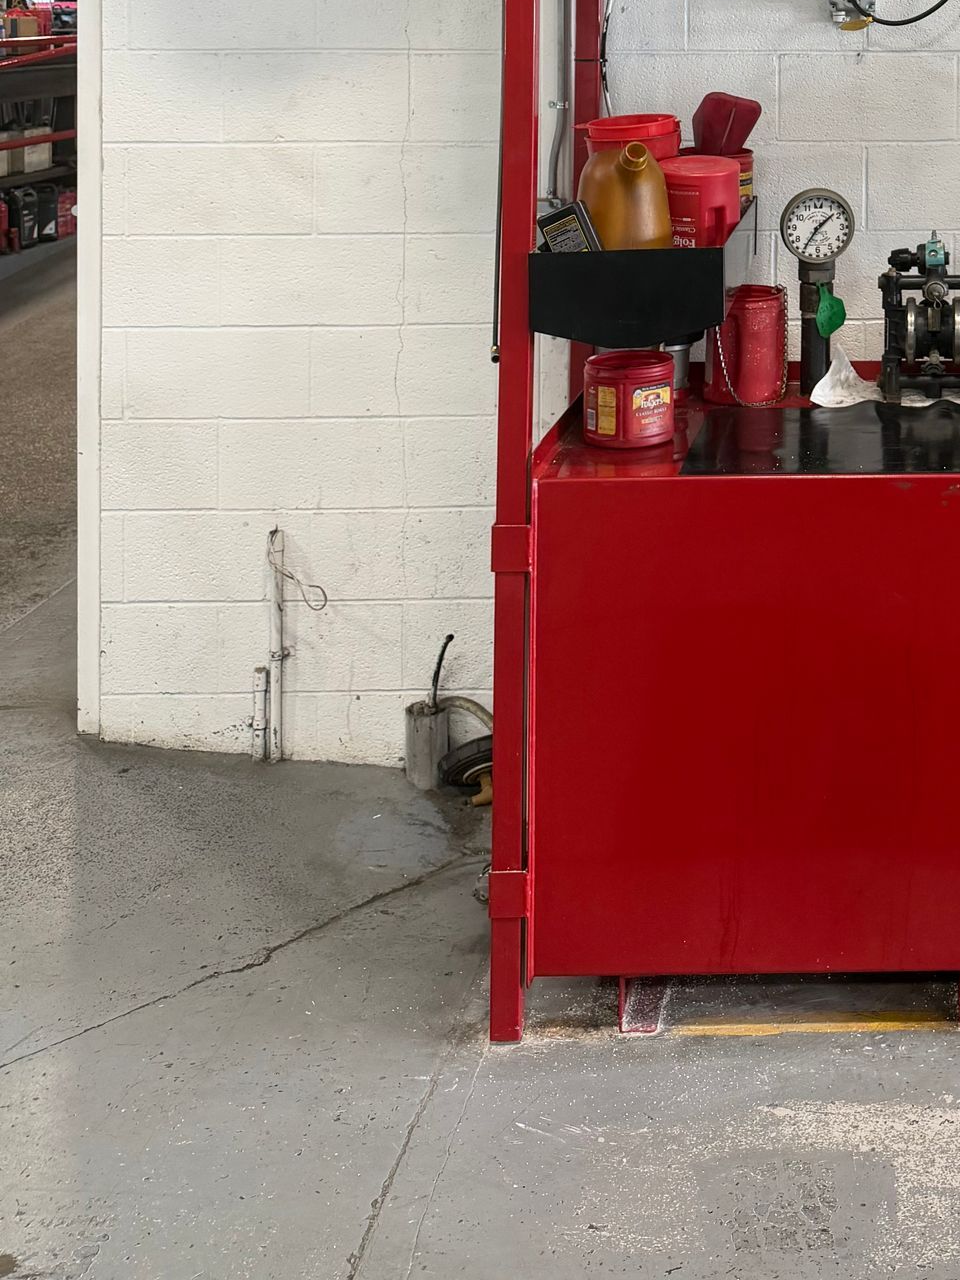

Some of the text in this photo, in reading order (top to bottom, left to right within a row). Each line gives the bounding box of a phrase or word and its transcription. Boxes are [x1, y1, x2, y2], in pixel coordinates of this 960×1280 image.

[804, 204, 811, 212] 11
[829, 204, 833, 212] 1
[836, 212, 842, 220] 2
[839, 223, 845, 231] 3
[795, 235, 801, 243] 8
[815, 246, 821, 254] 6
